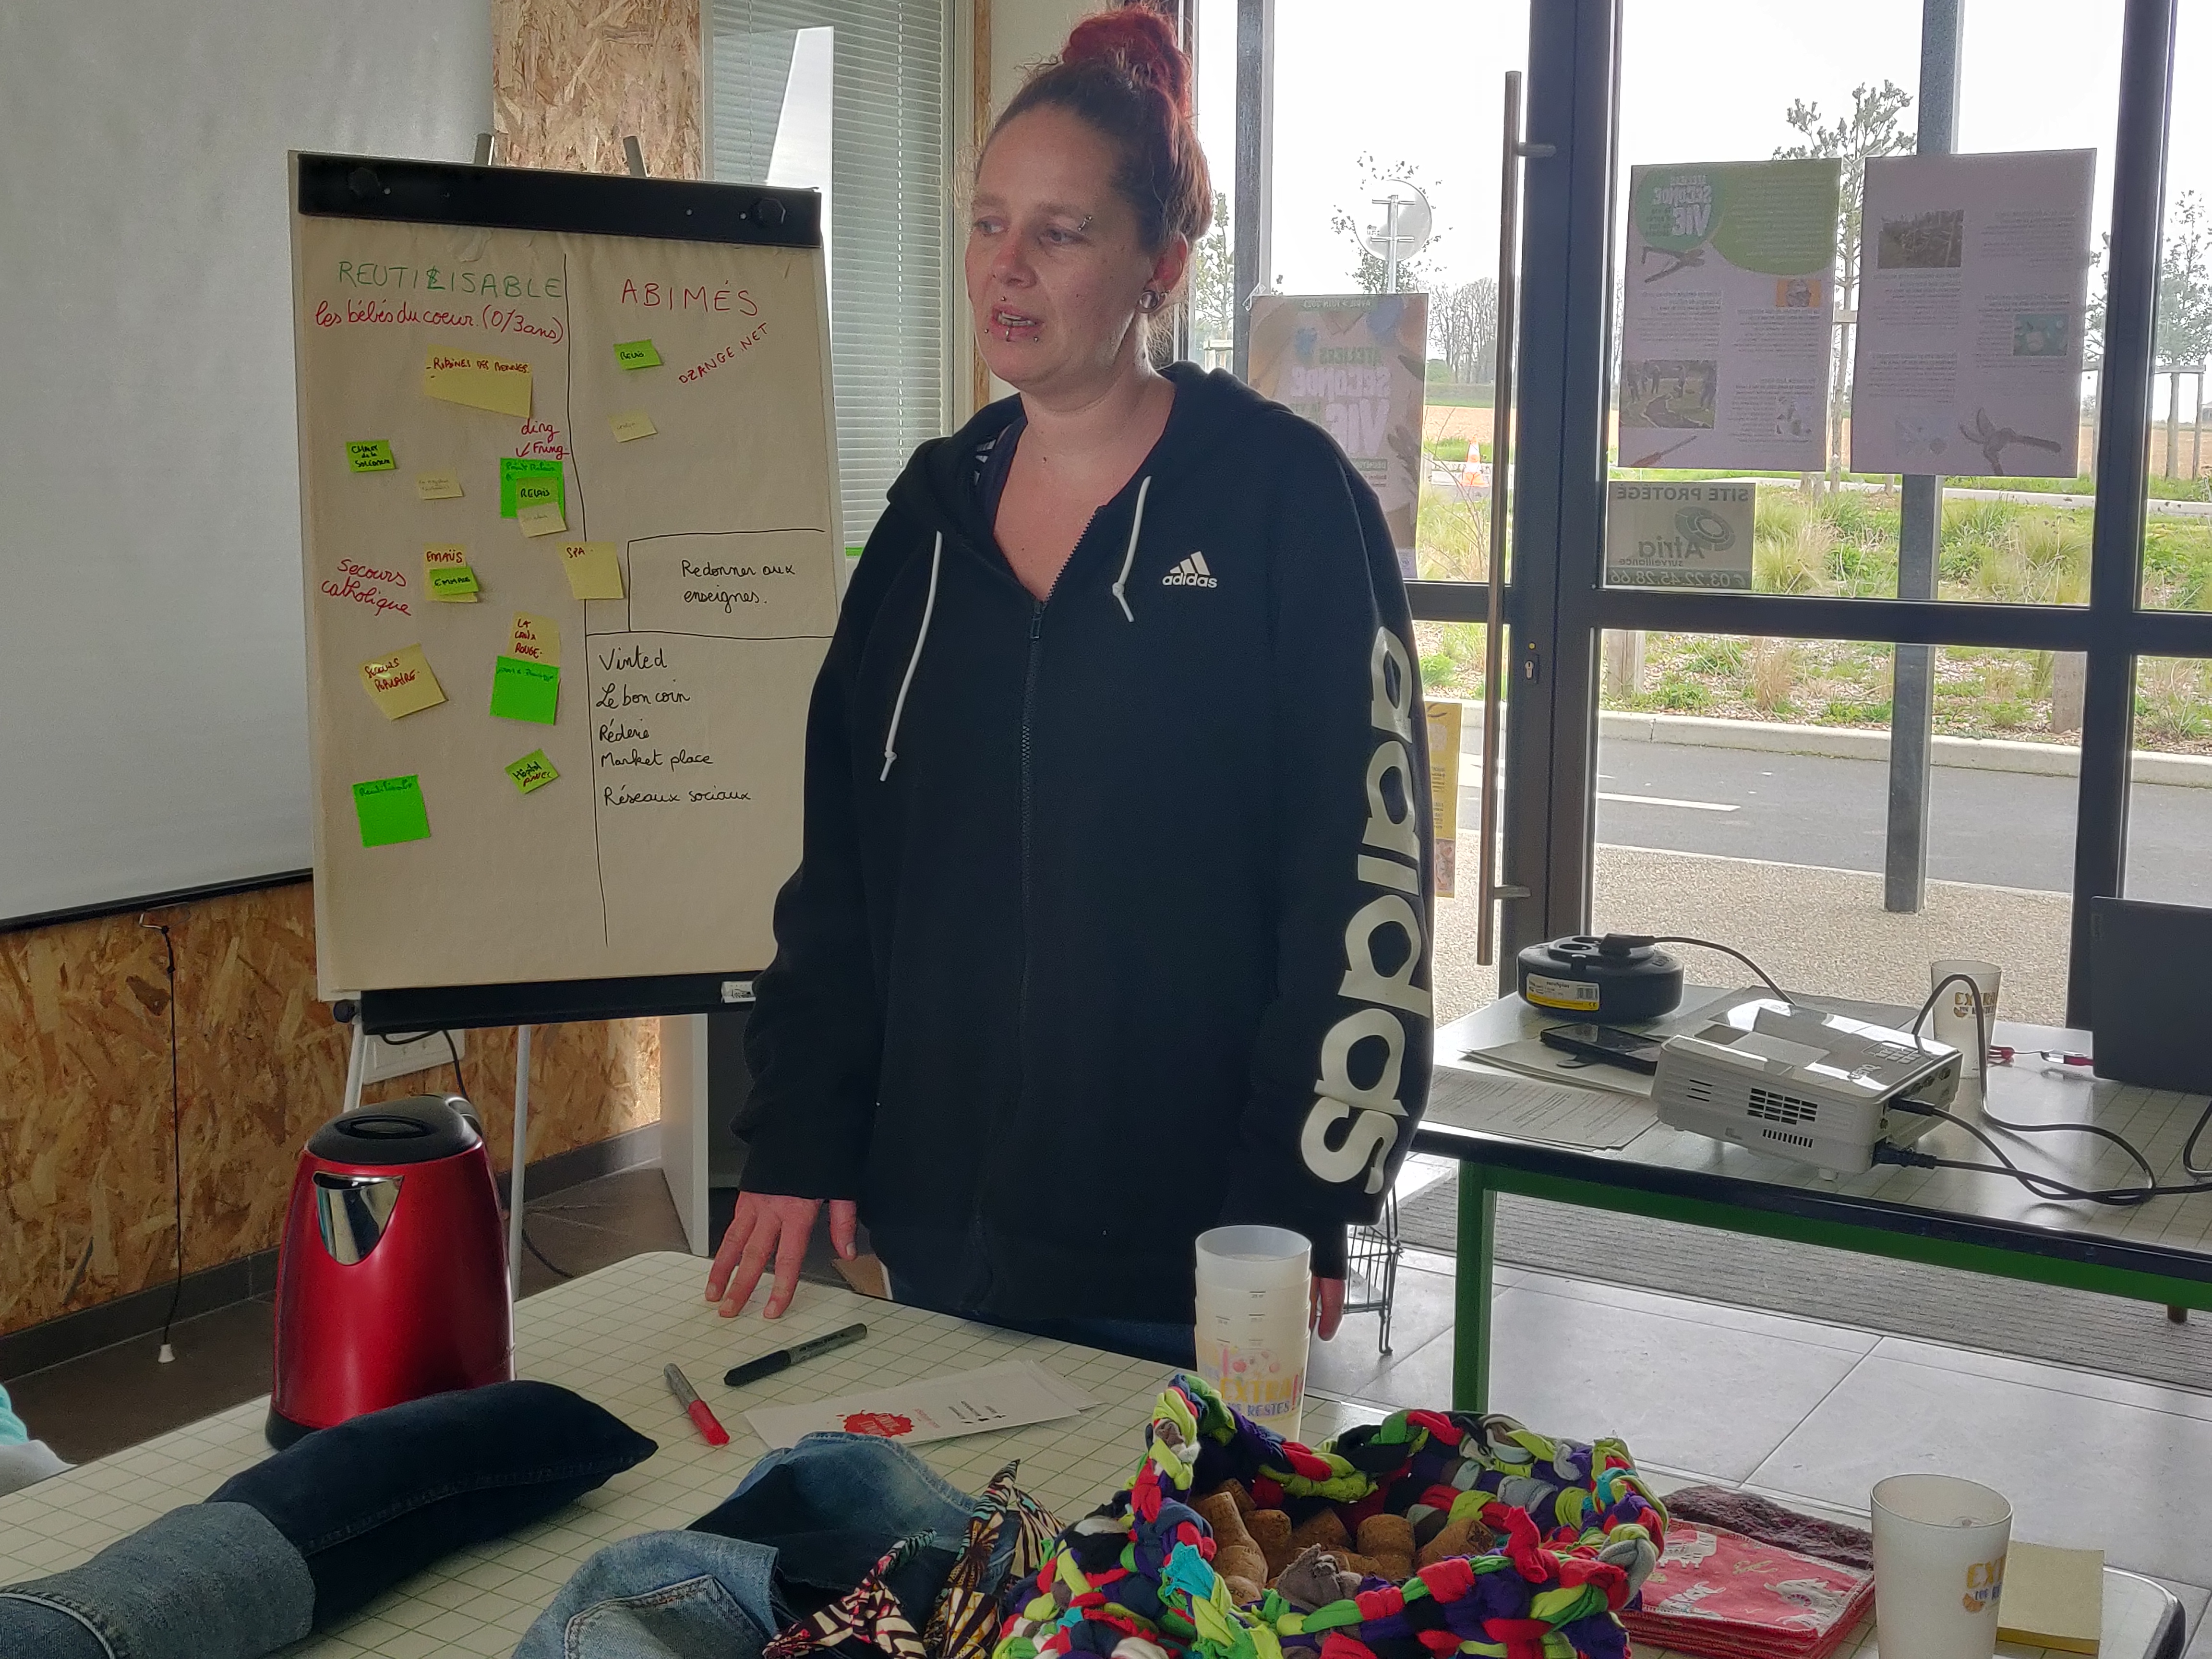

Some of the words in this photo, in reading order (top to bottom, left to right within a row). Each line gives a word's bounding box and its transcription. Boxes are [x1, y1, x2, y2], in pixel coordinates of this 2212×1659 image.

[622, 278, 758, 316] ABIMÉS
[315, 300, 341, 327] les
[348, 299, 393, 324] bébés
[397, 301, 421, 324] du
[521, 418, 560, 443] ding
[337, 559, 407, 587] Secours
[682, 559, 756, 577] Redonner
[763, 565, 796, 575] aux
[1162, 573, 1218, 588] adidas
[321, 577, 411, 616] catholique
[599, 645, 667, 671] Vinted
[596, 683, 618, 709] Le
[623, 684, 651, 705] bon
[655, 679, 690, 702] coin
[601, 749, 663, 768] Market
[671, 750, 713, 772] place
[604, 784, 680, 806] Réseaux
[688, 785, 751, 801] sociaux
[1301, 625, 1432, 1195] adidas
[1220, 1376, 1291, 1403] EXTRA
[1248, 1401, 1290, 1417] RESTES
